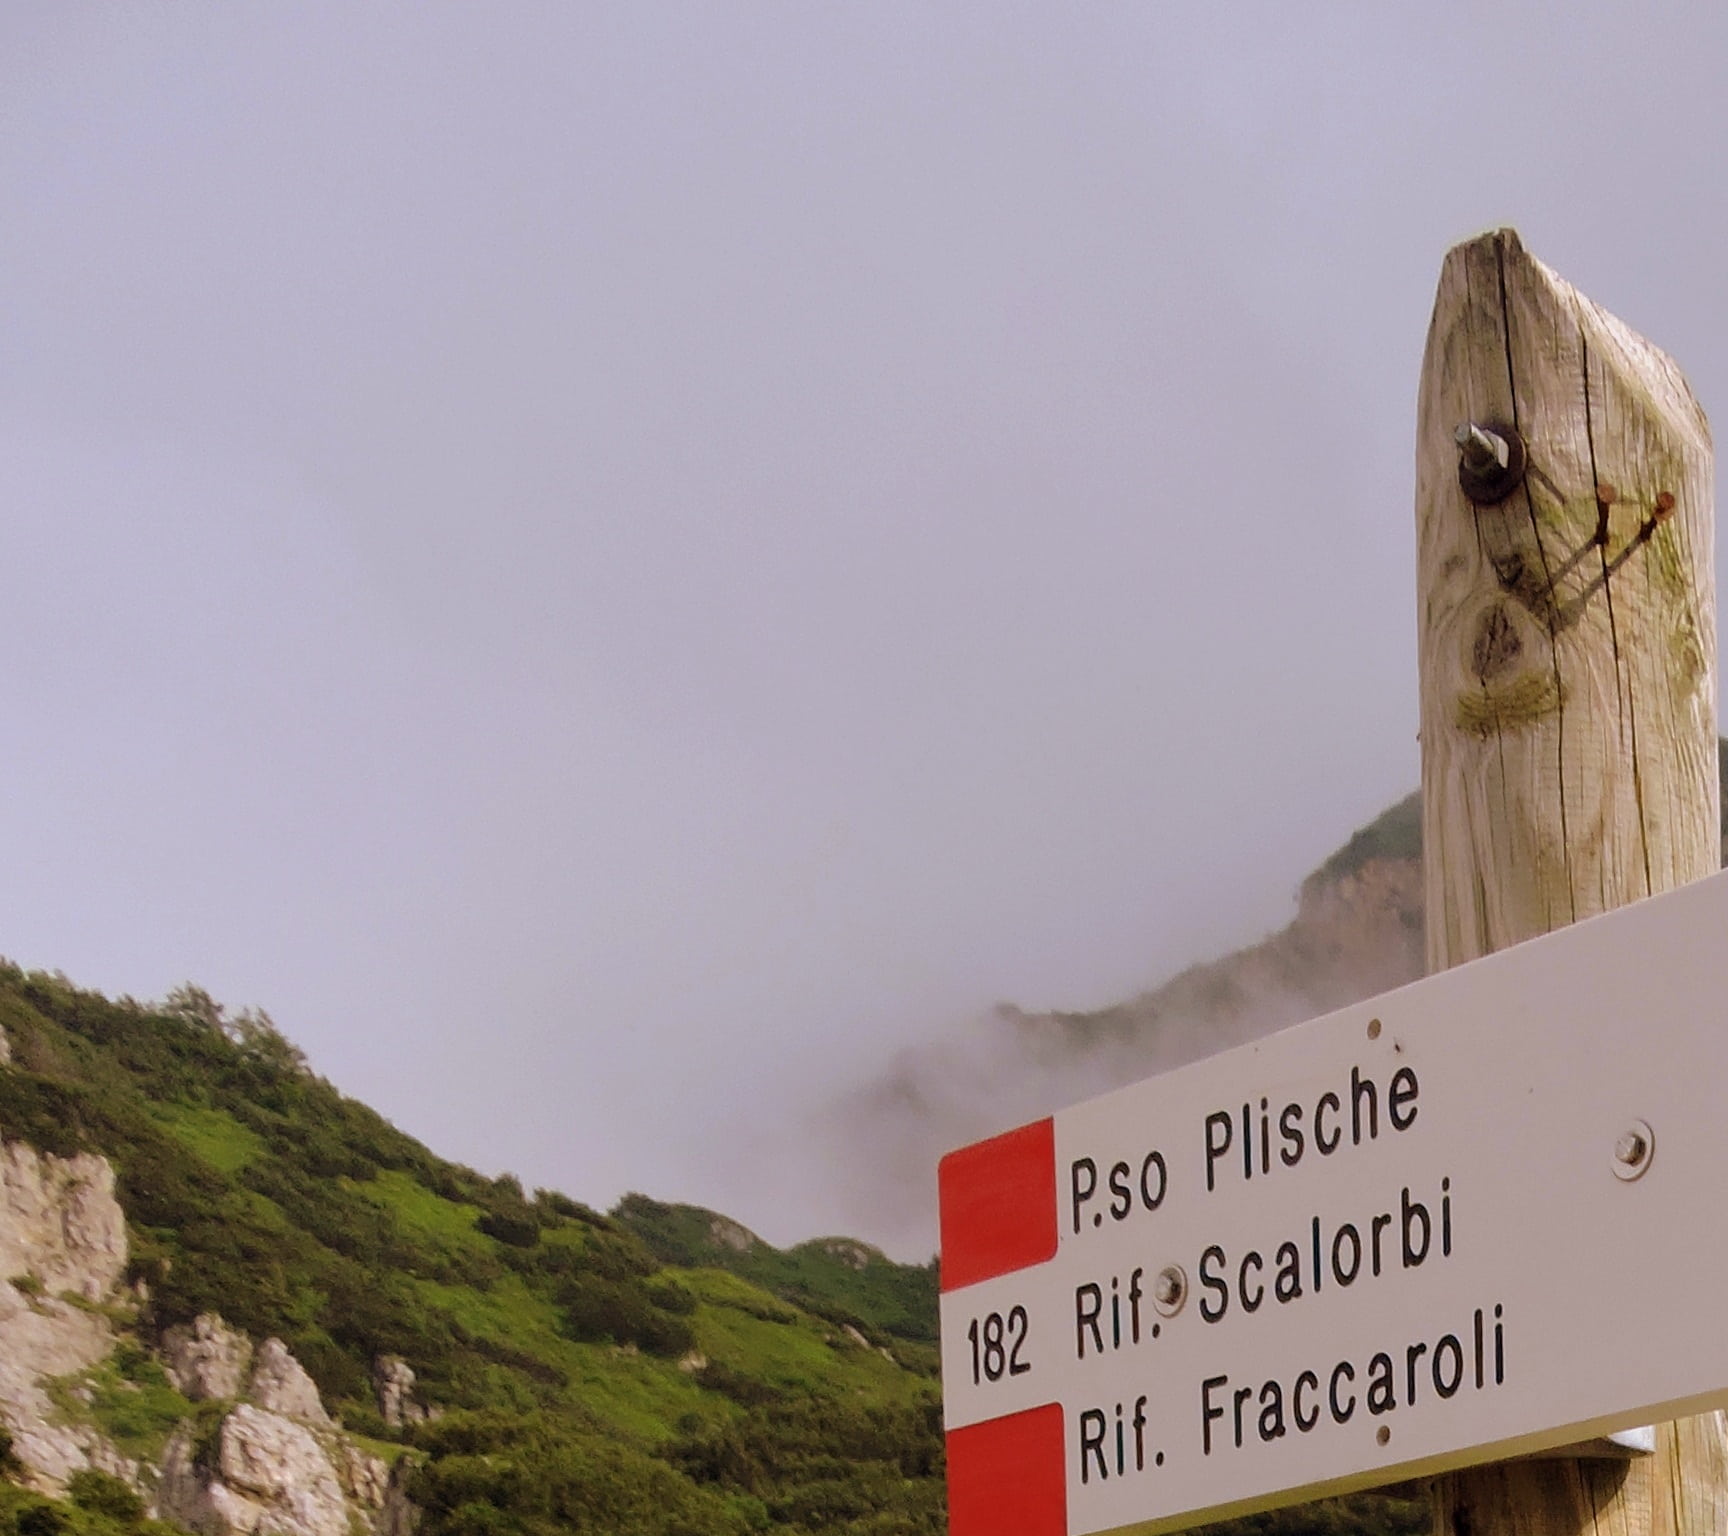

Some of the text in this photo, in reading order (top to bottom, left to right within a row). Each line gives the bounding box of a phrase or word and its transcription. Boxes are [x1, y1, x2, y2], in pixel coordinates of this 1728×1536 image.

[1072, 1151, 1167, 1234] P.so
[1205, 1066, 1419, 1192] Plische
[968, 1305, 1031, 1385] 182
[1076, 1268, 1160, 1359] Rif.
[1199, 1176, 1453, 1323] Scalorbi
[1080, 1396, 1164, 1484] Rif.
[1199, 1303, 1504, 1455] Fraccaroli
